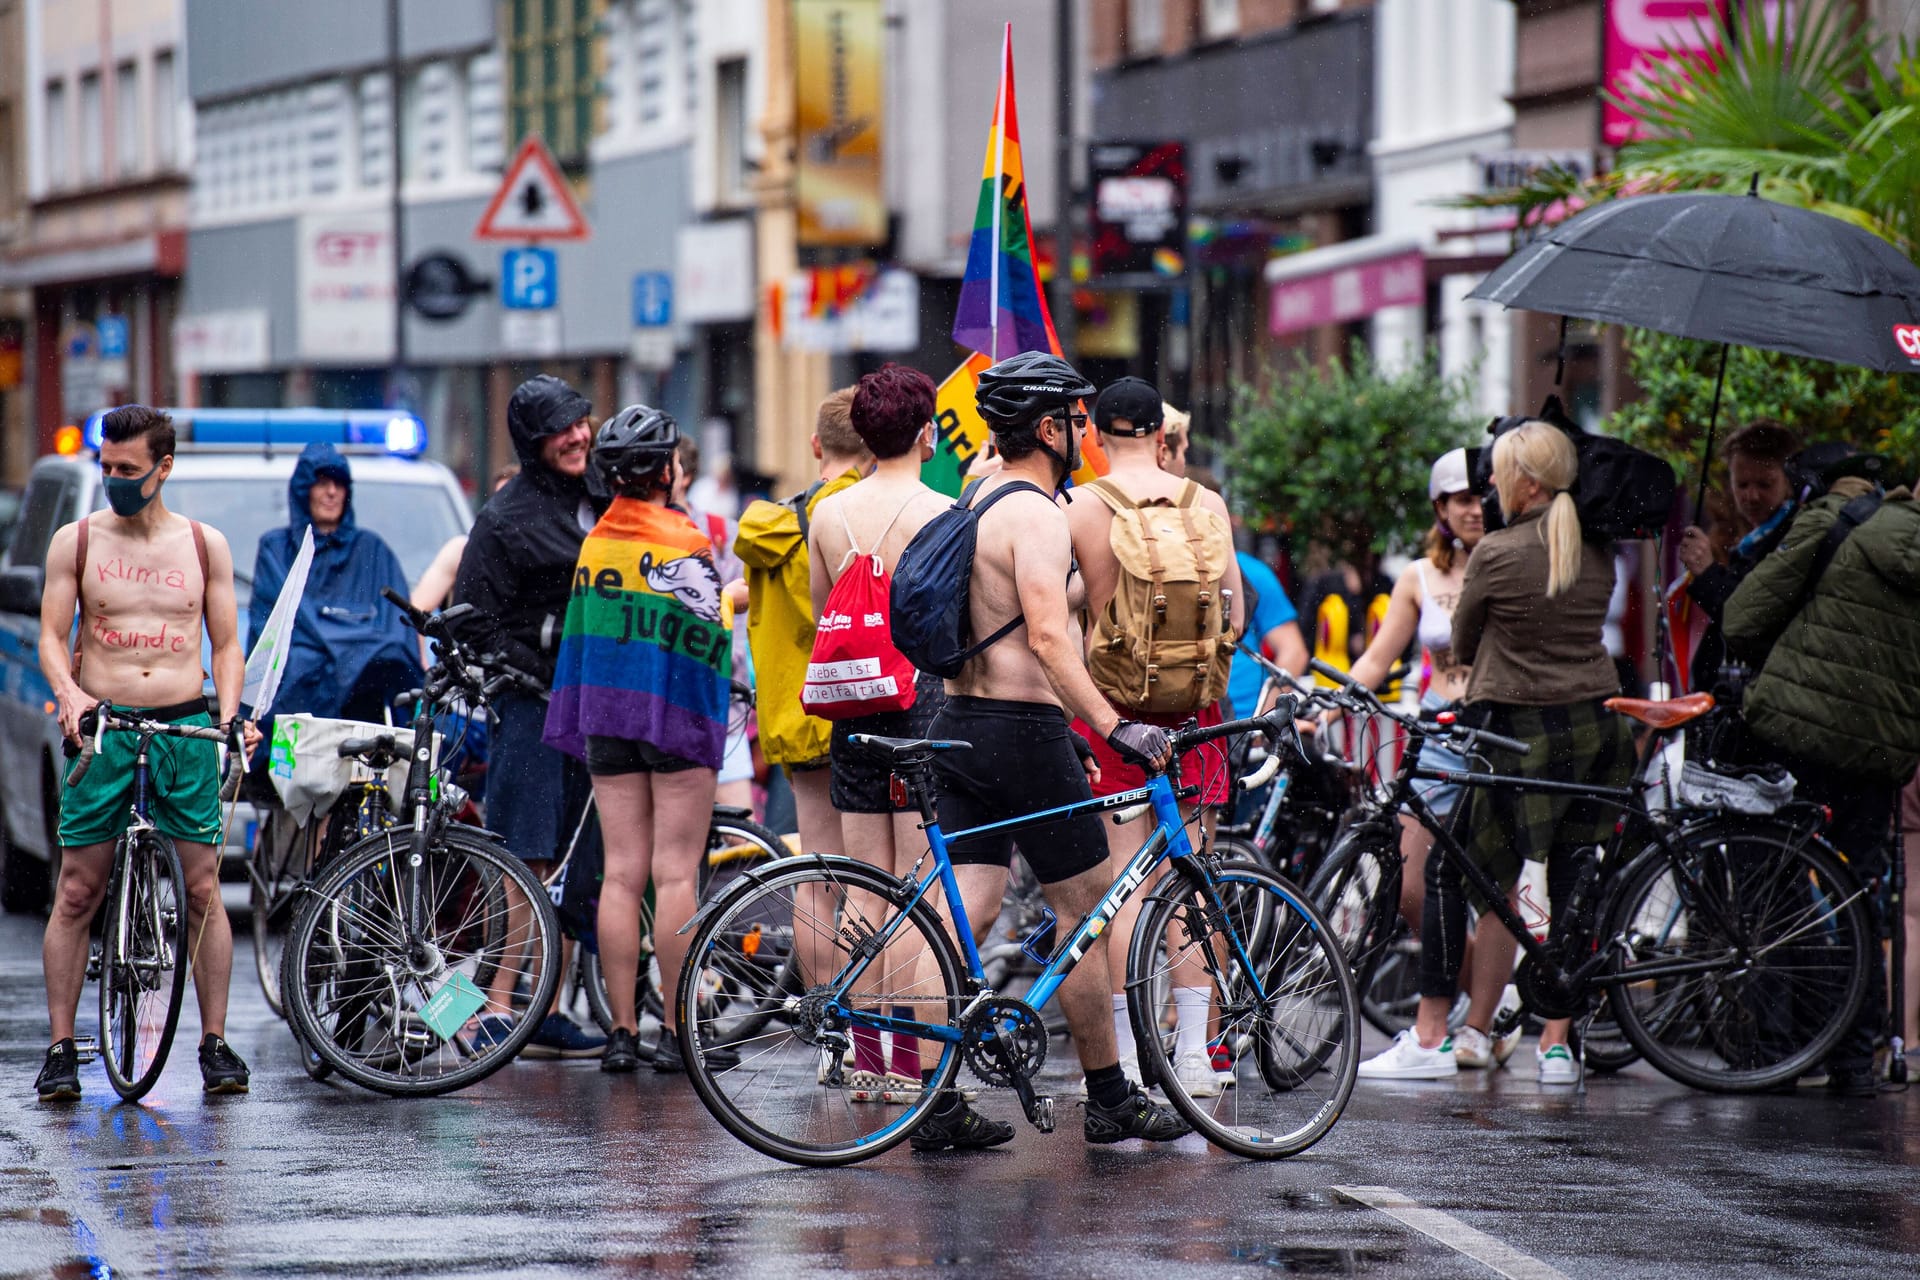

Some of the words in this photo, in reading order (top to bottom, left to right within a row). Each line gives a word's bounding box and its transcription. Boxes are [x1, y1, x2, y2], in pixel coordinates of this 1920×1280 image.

[1022, 385, 1064, 393] CRATONI
[96, 558, 187, 592] Klima
[93, 615, 185, 653] Freunde
[808, 665, 838, 679] Liebe
[847, 662, 872, 676] ist
[1103, 791, 1148, 807] CUBE
